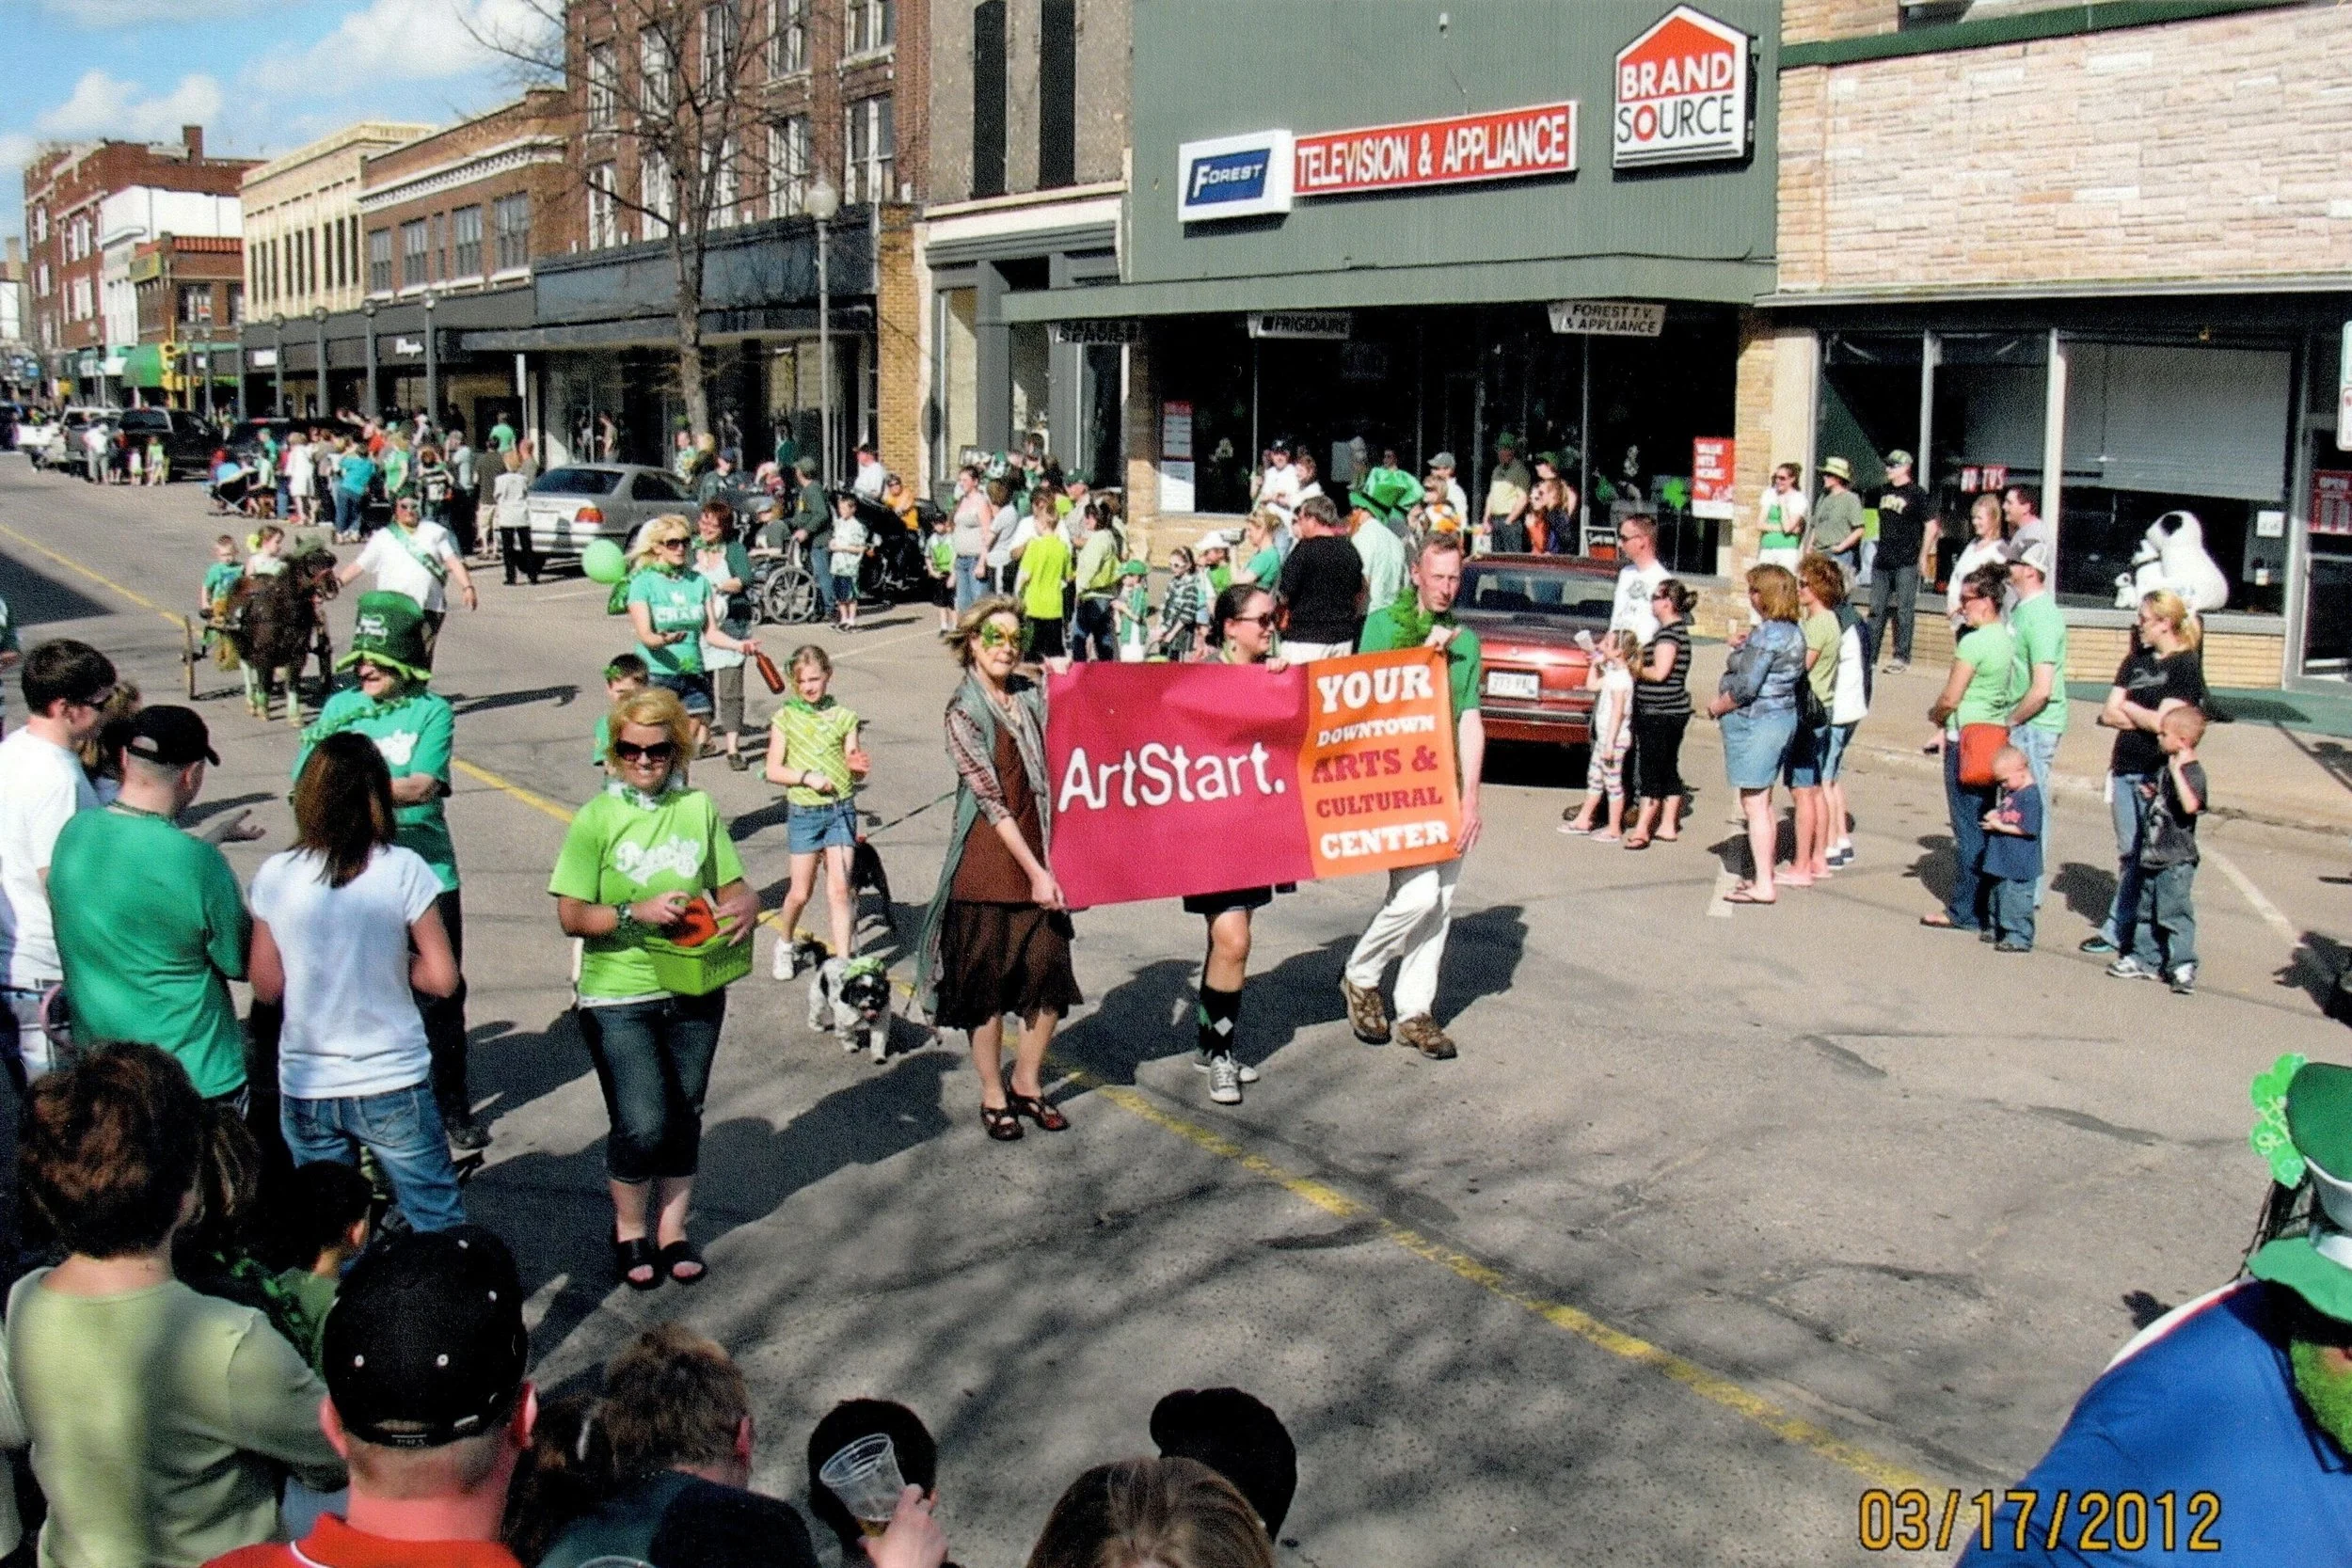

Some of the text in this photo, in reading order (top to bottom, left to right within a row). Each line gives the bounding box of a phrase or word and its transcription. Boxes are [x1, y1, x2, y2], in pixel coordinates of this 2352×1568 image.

[1621, 52, 1733, 100] BRAND
[1617, 94, 1734, 143] SOURCE
[1297, 114, 1567, 187] TELEVISION & APPLIANCE
[1274, 316, 1350, 333] FRIGIDAIRE
[1572, 304, 1629, 319] FOREST
[1578, 318, 1657, 333] APPLIANCE
[1317, 664, 1434, 714] YOUR
[1317, 715, 1436, 748] DOWNTOWN
[1057, 741, 1287, 813] ArtStart.
[1311, 745, 1438, 784] ARTS &
[1316, 786, 1443, 818] CULTURAL
[1320, 820, 1450, 860] CENTER
